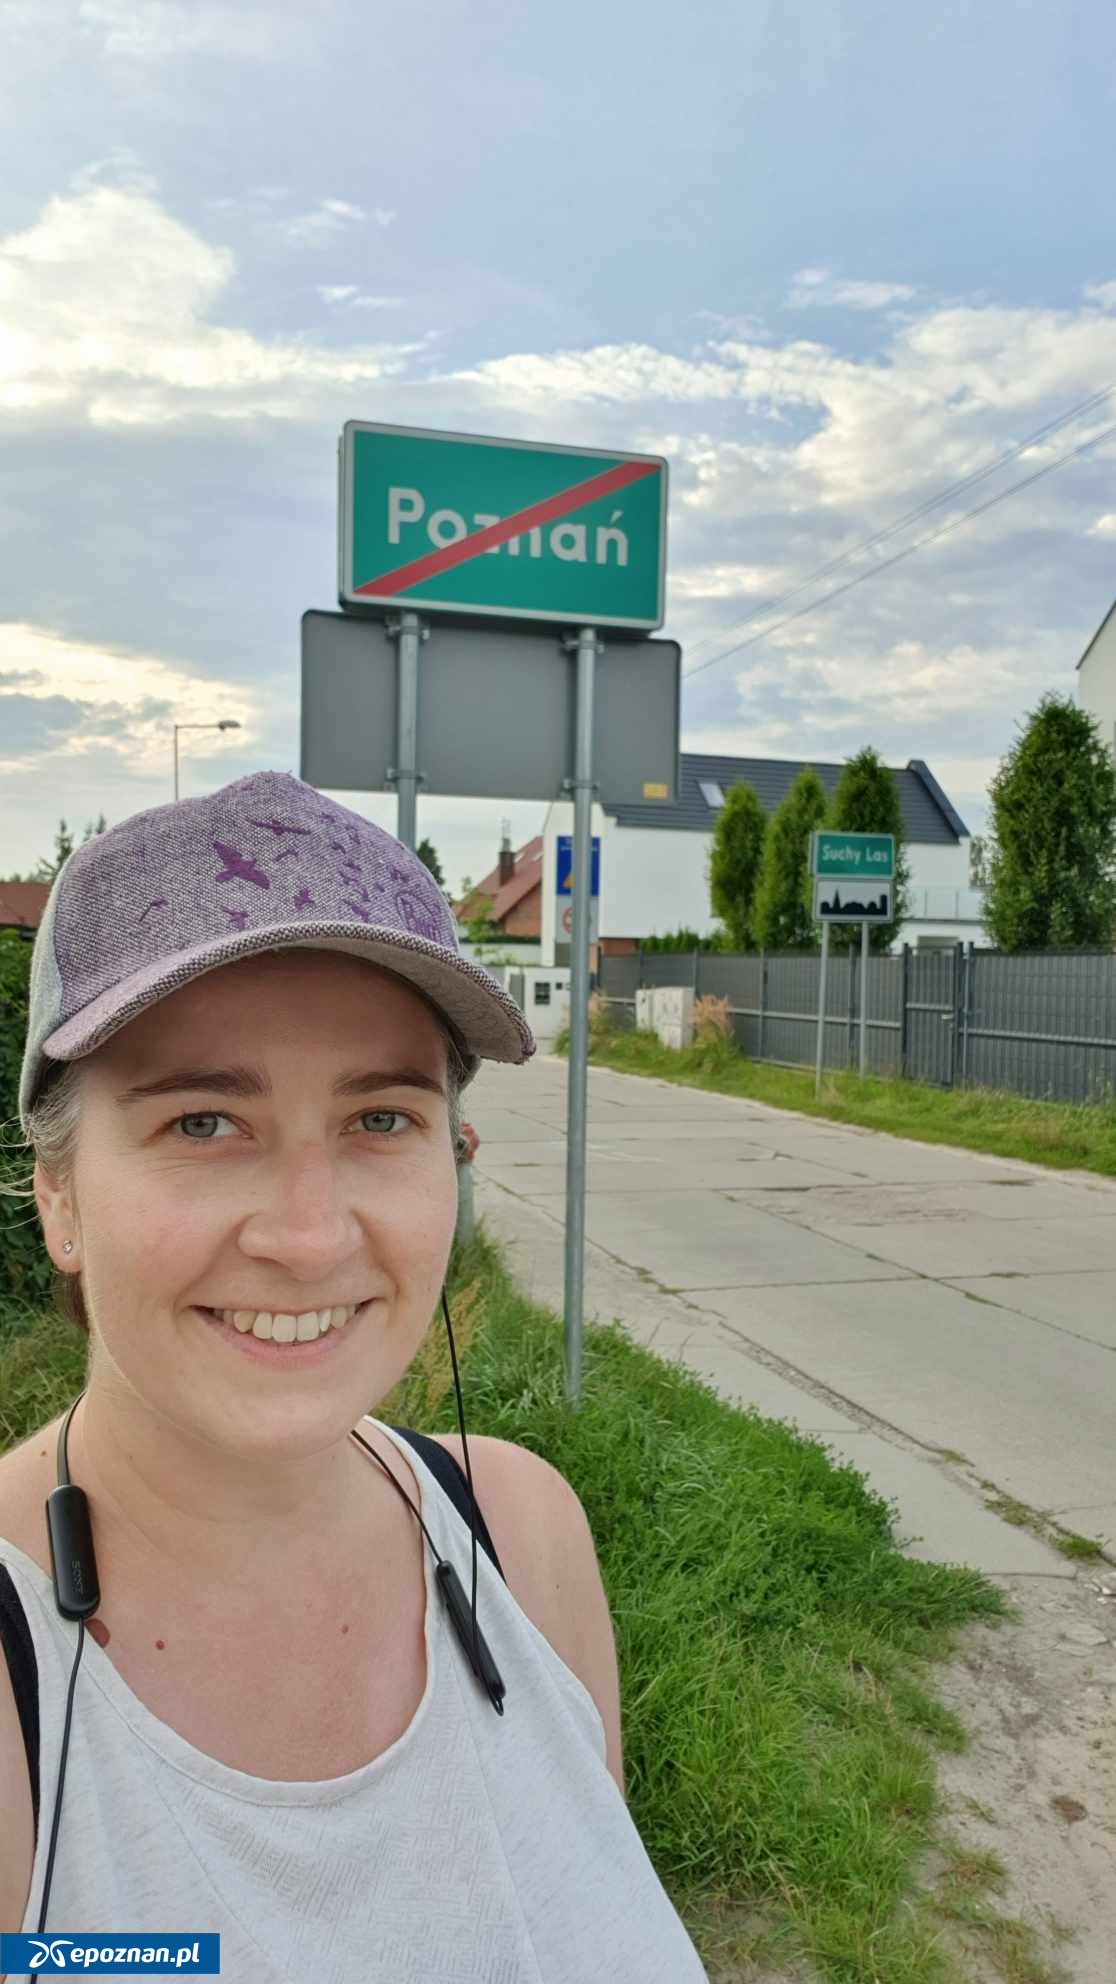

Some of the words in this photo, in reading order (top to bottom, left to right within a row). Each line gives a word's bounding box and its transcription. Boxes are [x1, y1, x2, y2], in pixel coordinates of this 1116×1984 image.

[387, 486, 629, 567] Poznań
[822, 844, 861, 865] Suchy
[866, 847, 888, 863] Las
